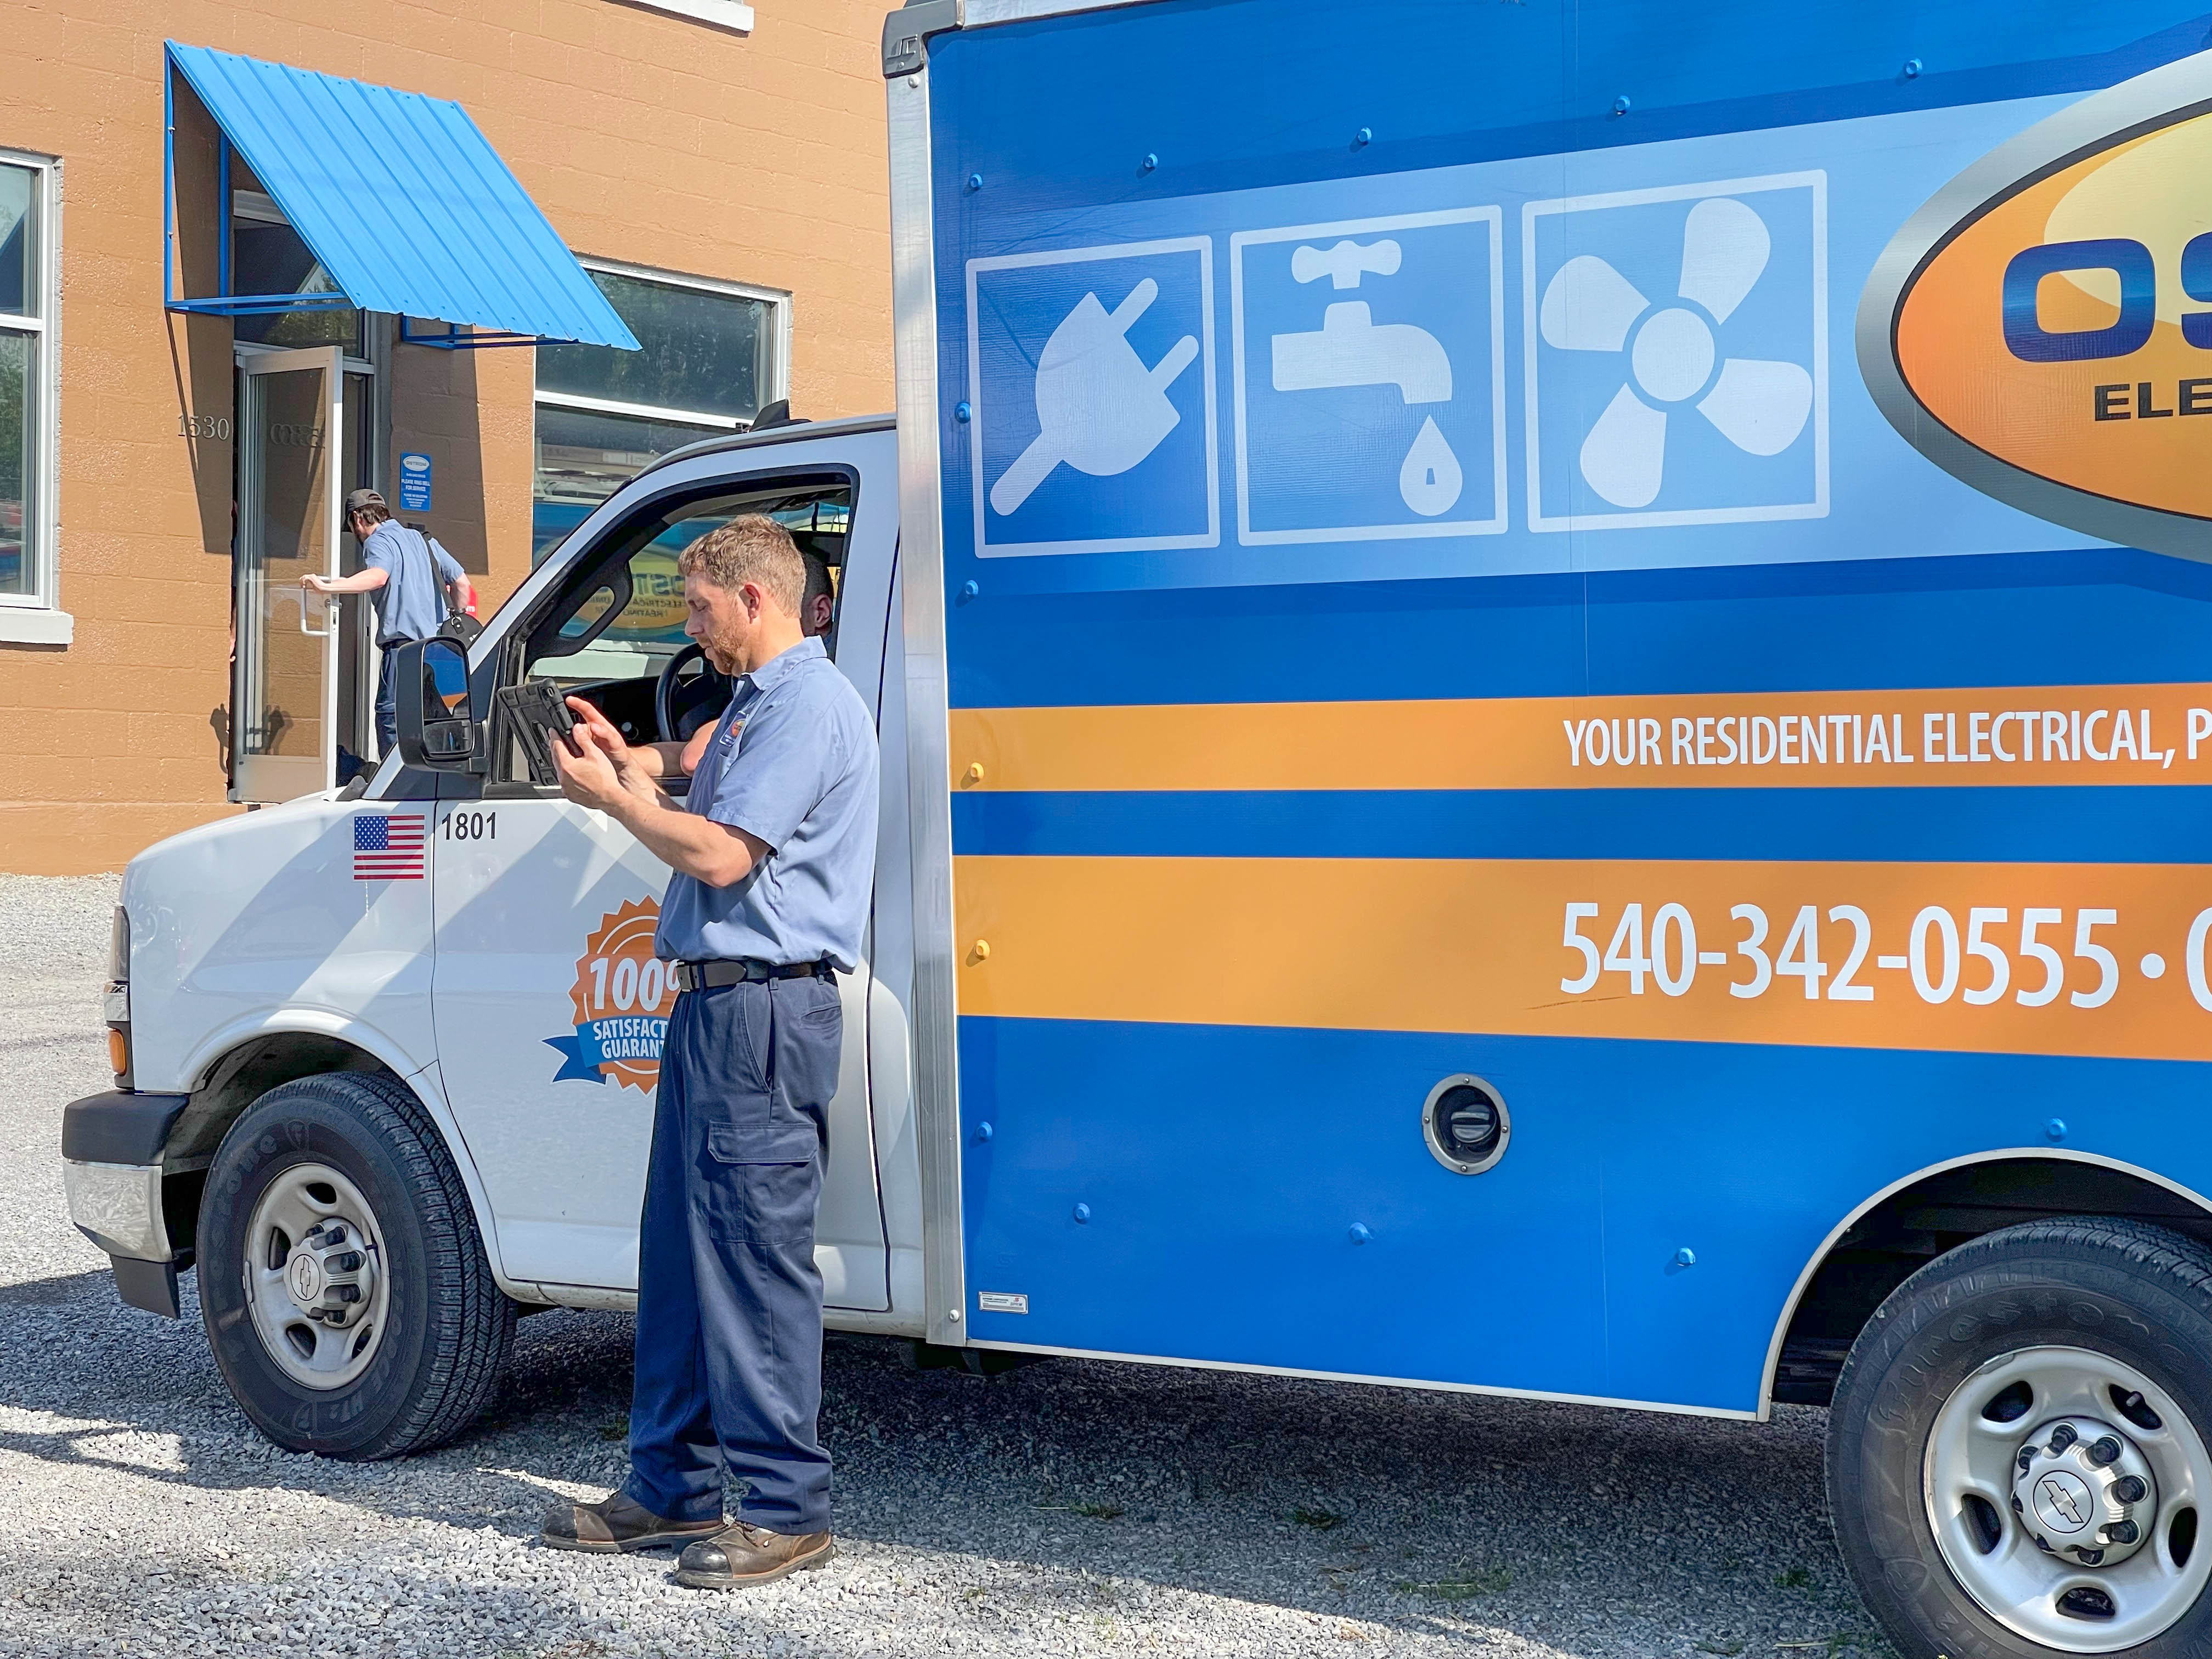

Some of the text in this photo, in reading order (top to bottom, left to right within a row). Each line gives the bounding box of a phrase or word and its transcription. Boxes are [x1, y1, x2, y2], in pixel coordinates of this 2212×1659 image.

[2002, 232, 2212, 363] O
[2095, 378, 2212, 421] ELE
[178, 413, 229, 441] 1530
[1564, 719, 1662, 766] YOUR
[1672, 714, 1914, 764] RESIDENTIAL
[1924, 709, 2175, 769] ELECTRICAL,
[442, 812, 496, 840] 1801
[1561, 903, 2118, 1008] 540-342-0555
